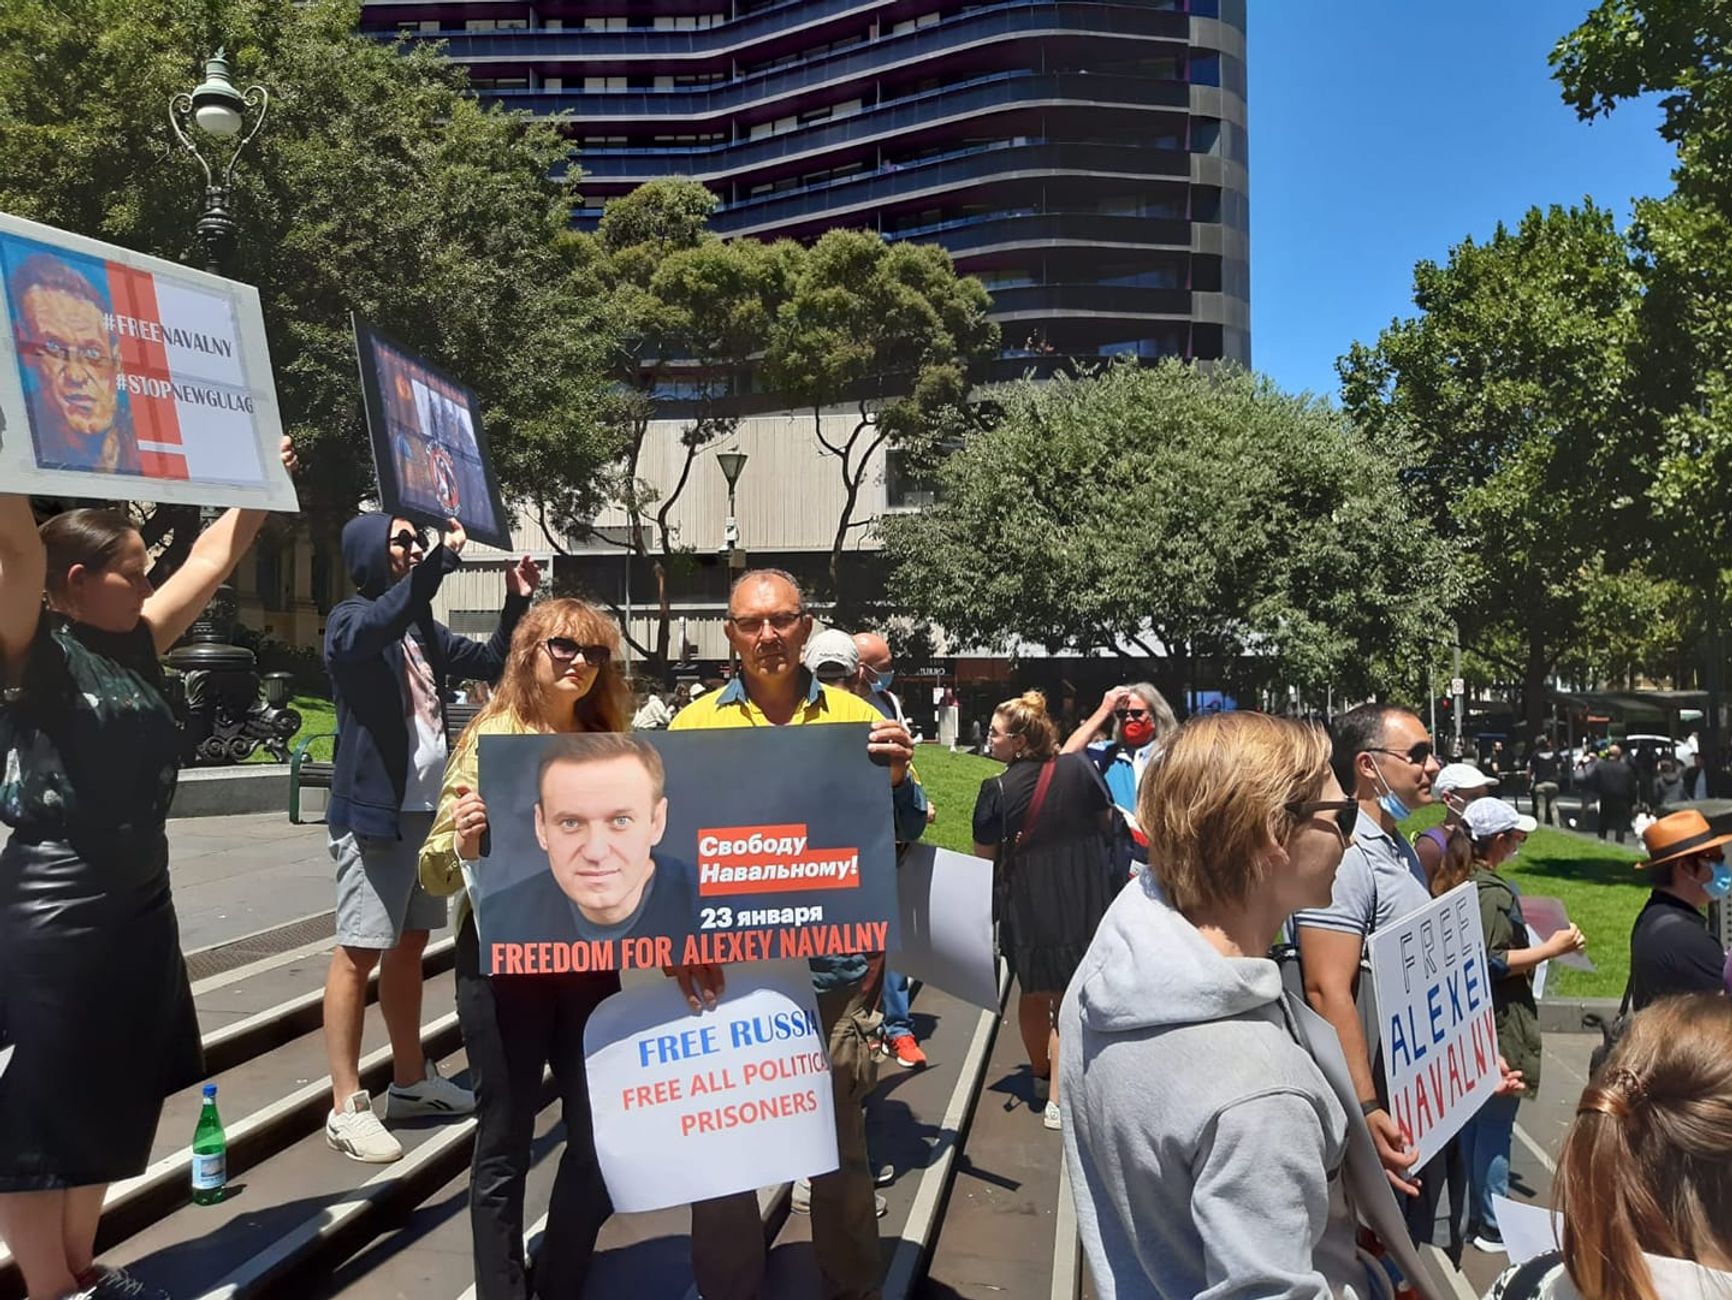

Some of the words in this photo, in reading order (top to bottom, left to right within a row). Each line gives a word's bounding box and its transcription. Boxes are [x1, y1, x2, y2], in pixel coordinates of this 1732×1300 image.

[103, 312, 232, 358] #FREENAVALNY
[116, 373, 254, 414] #STOPNEWGULAG
[700, 833, 807, 857] Свободу
[700, 855, 859, 884] Навальному!
[701, 907, 733, 930] 23
[737, 905, 823, 927] января
[491, 939, 613, 975] FREEDOM
[621, 936, 673, 970] FOR
[682, 928, 774, 966] ALEXEY
[779, 921, 889, 960] NAVALNY
[1400, 896, 1472, 994] FREE
[638, 1025, 720, 1067] FREE
[622, 1079, 682, 1111] FREE
[690, 1069, 736, 1097] ALL
[1394, 1006, 1497, 1147] NAVALNY
[680, 1090, 818, 1136] PRISONERS
